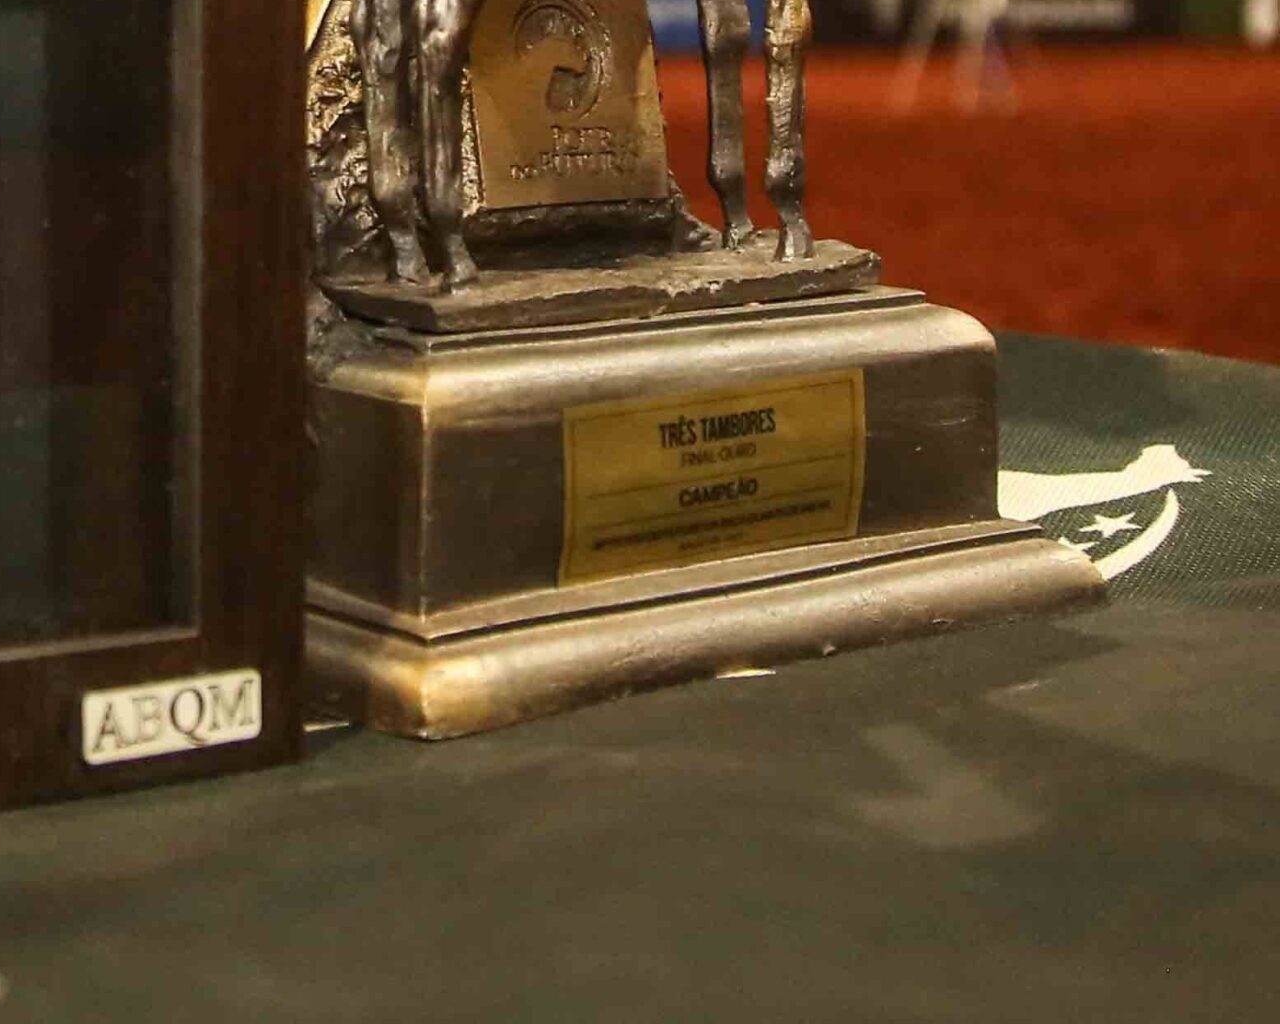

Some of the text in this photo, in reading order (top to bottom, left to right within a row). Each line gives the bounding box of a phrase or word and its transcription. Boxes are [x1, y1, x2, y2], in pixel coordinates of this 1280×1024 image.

[658, 407, 777, 449] TRÊS TAMBORES
[678, 478, 759, 508] CAMPEÃO
[91, 679, 255, 754] ABQM
